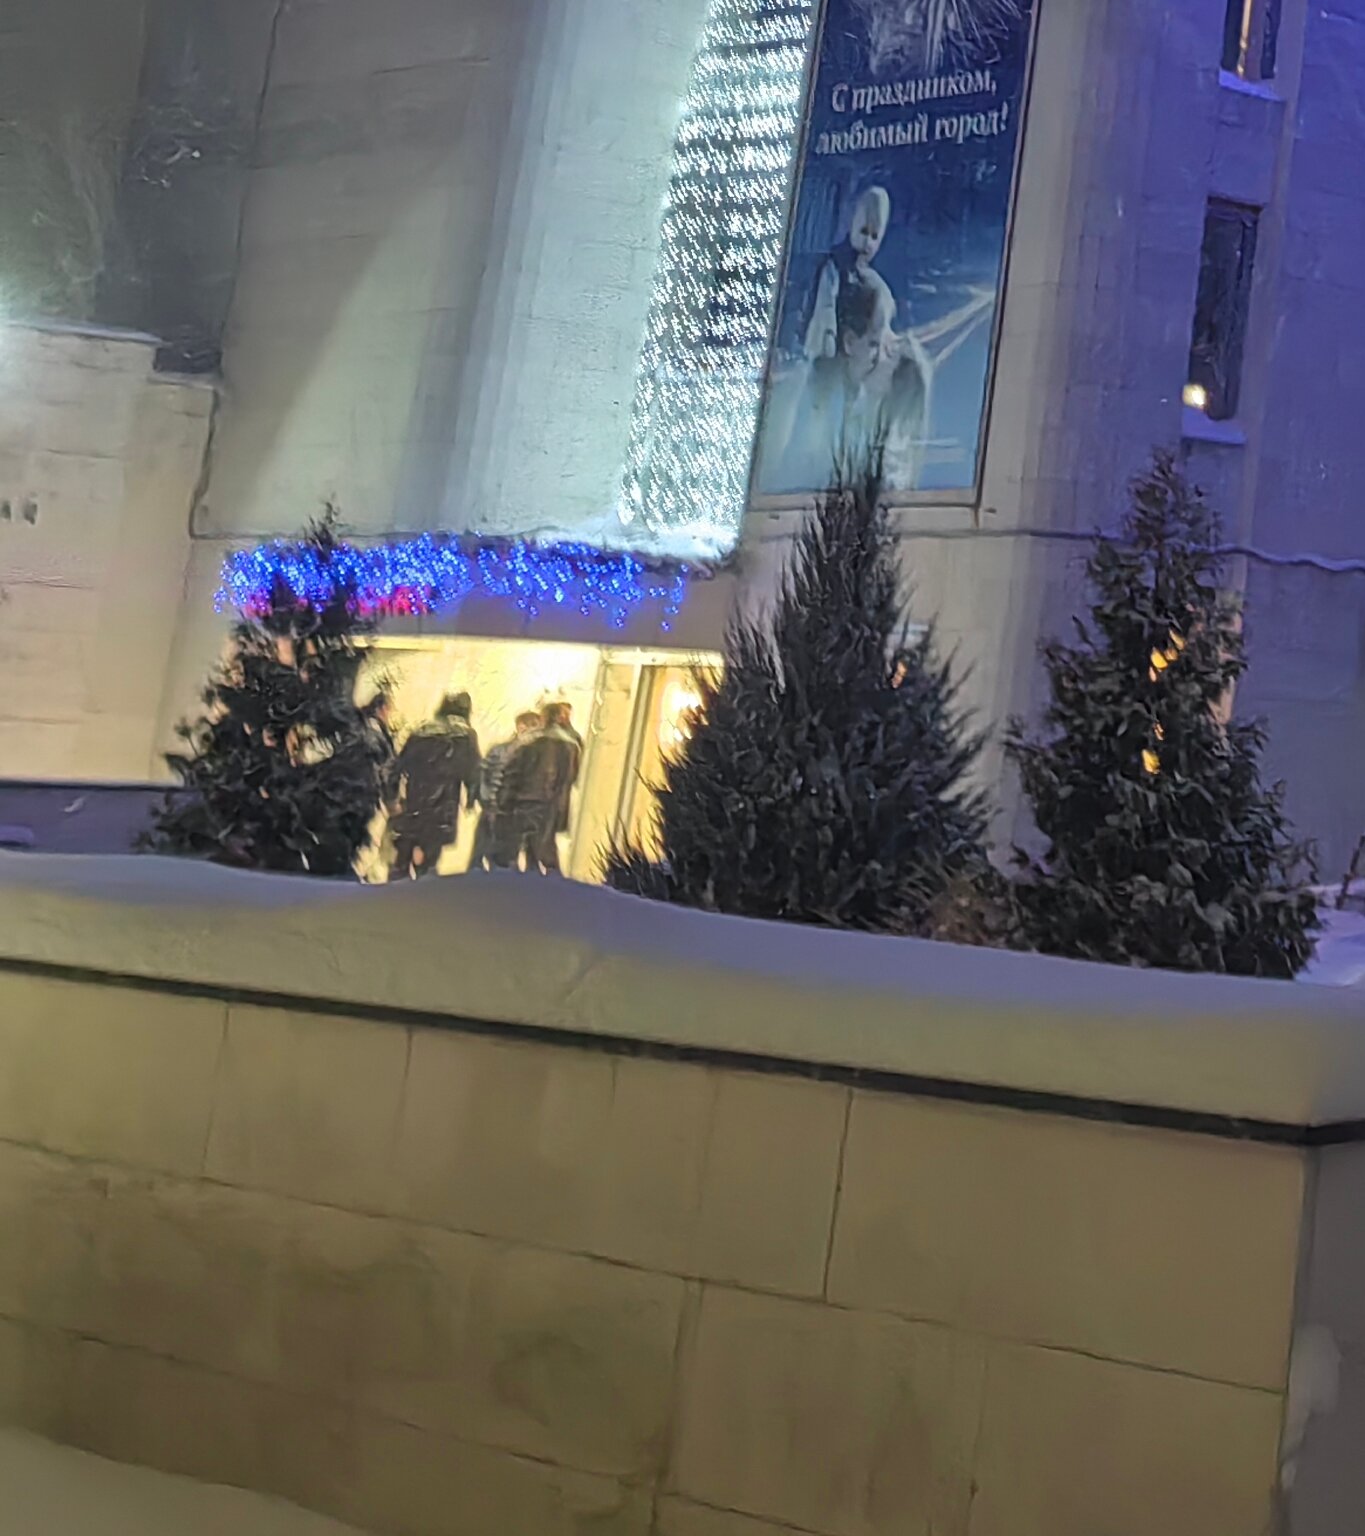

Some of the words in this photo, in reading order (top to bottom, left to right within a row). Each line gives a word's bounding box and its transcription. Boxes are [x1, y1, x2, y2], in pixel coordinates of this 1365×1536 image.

[831, 82, 848, 113] С
[852, 68, 997, 114] праздником,
[815, 112, 929, 155] любимый
[934, 101, 1009, 144] город!
